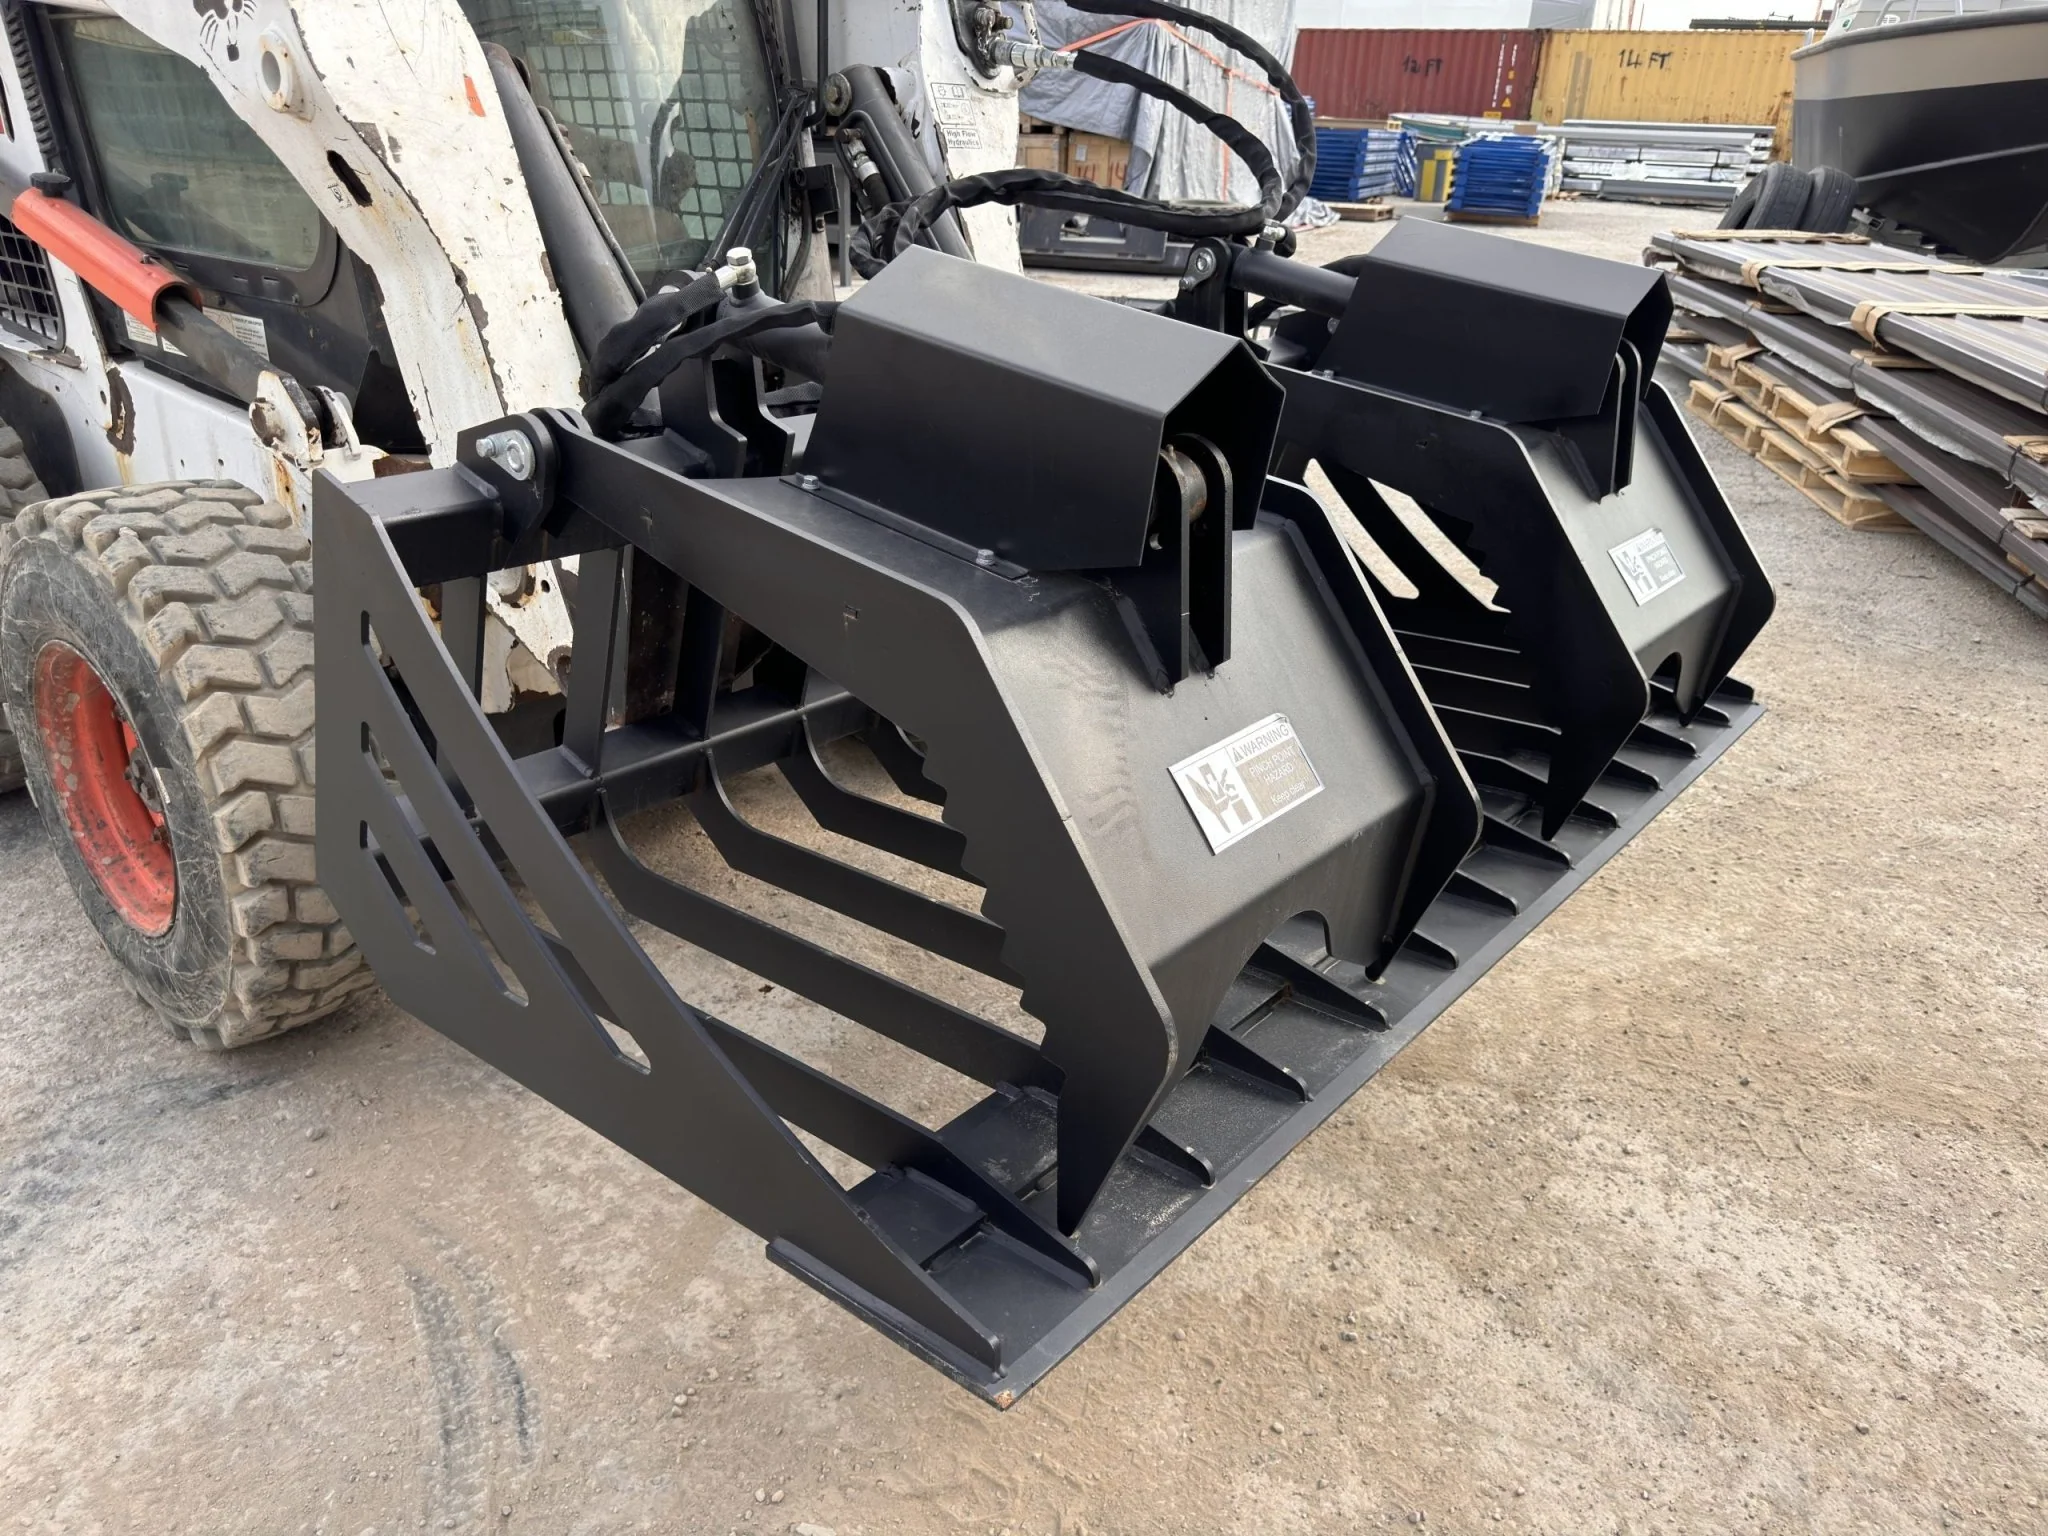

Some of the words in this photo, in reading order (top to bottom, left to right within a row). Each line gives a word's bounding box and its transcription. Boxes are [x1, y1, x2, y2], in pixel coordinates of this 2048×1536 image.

[1403, 55, 1421, 74] 12
[1425, 57, 1444, 76] FT
[1619, 48, 1642, 69] 14
[1648, 51, 1673, 70] FT
[947, 129, 961, 138] High
[962, 130, 976, 138] Flow
[948, 138, 980, 147] Hydraulics
[1240, 723, 1289, 757] WARNING
[1249, 758, 1274, 777] PINCH
[1271, 745, 1296, 764] POINT
[1263, 762, 1294, 784] HAZARD
[1270, 789, 1291, 806] Keep
[1287, 780, 1305, 795] clear
